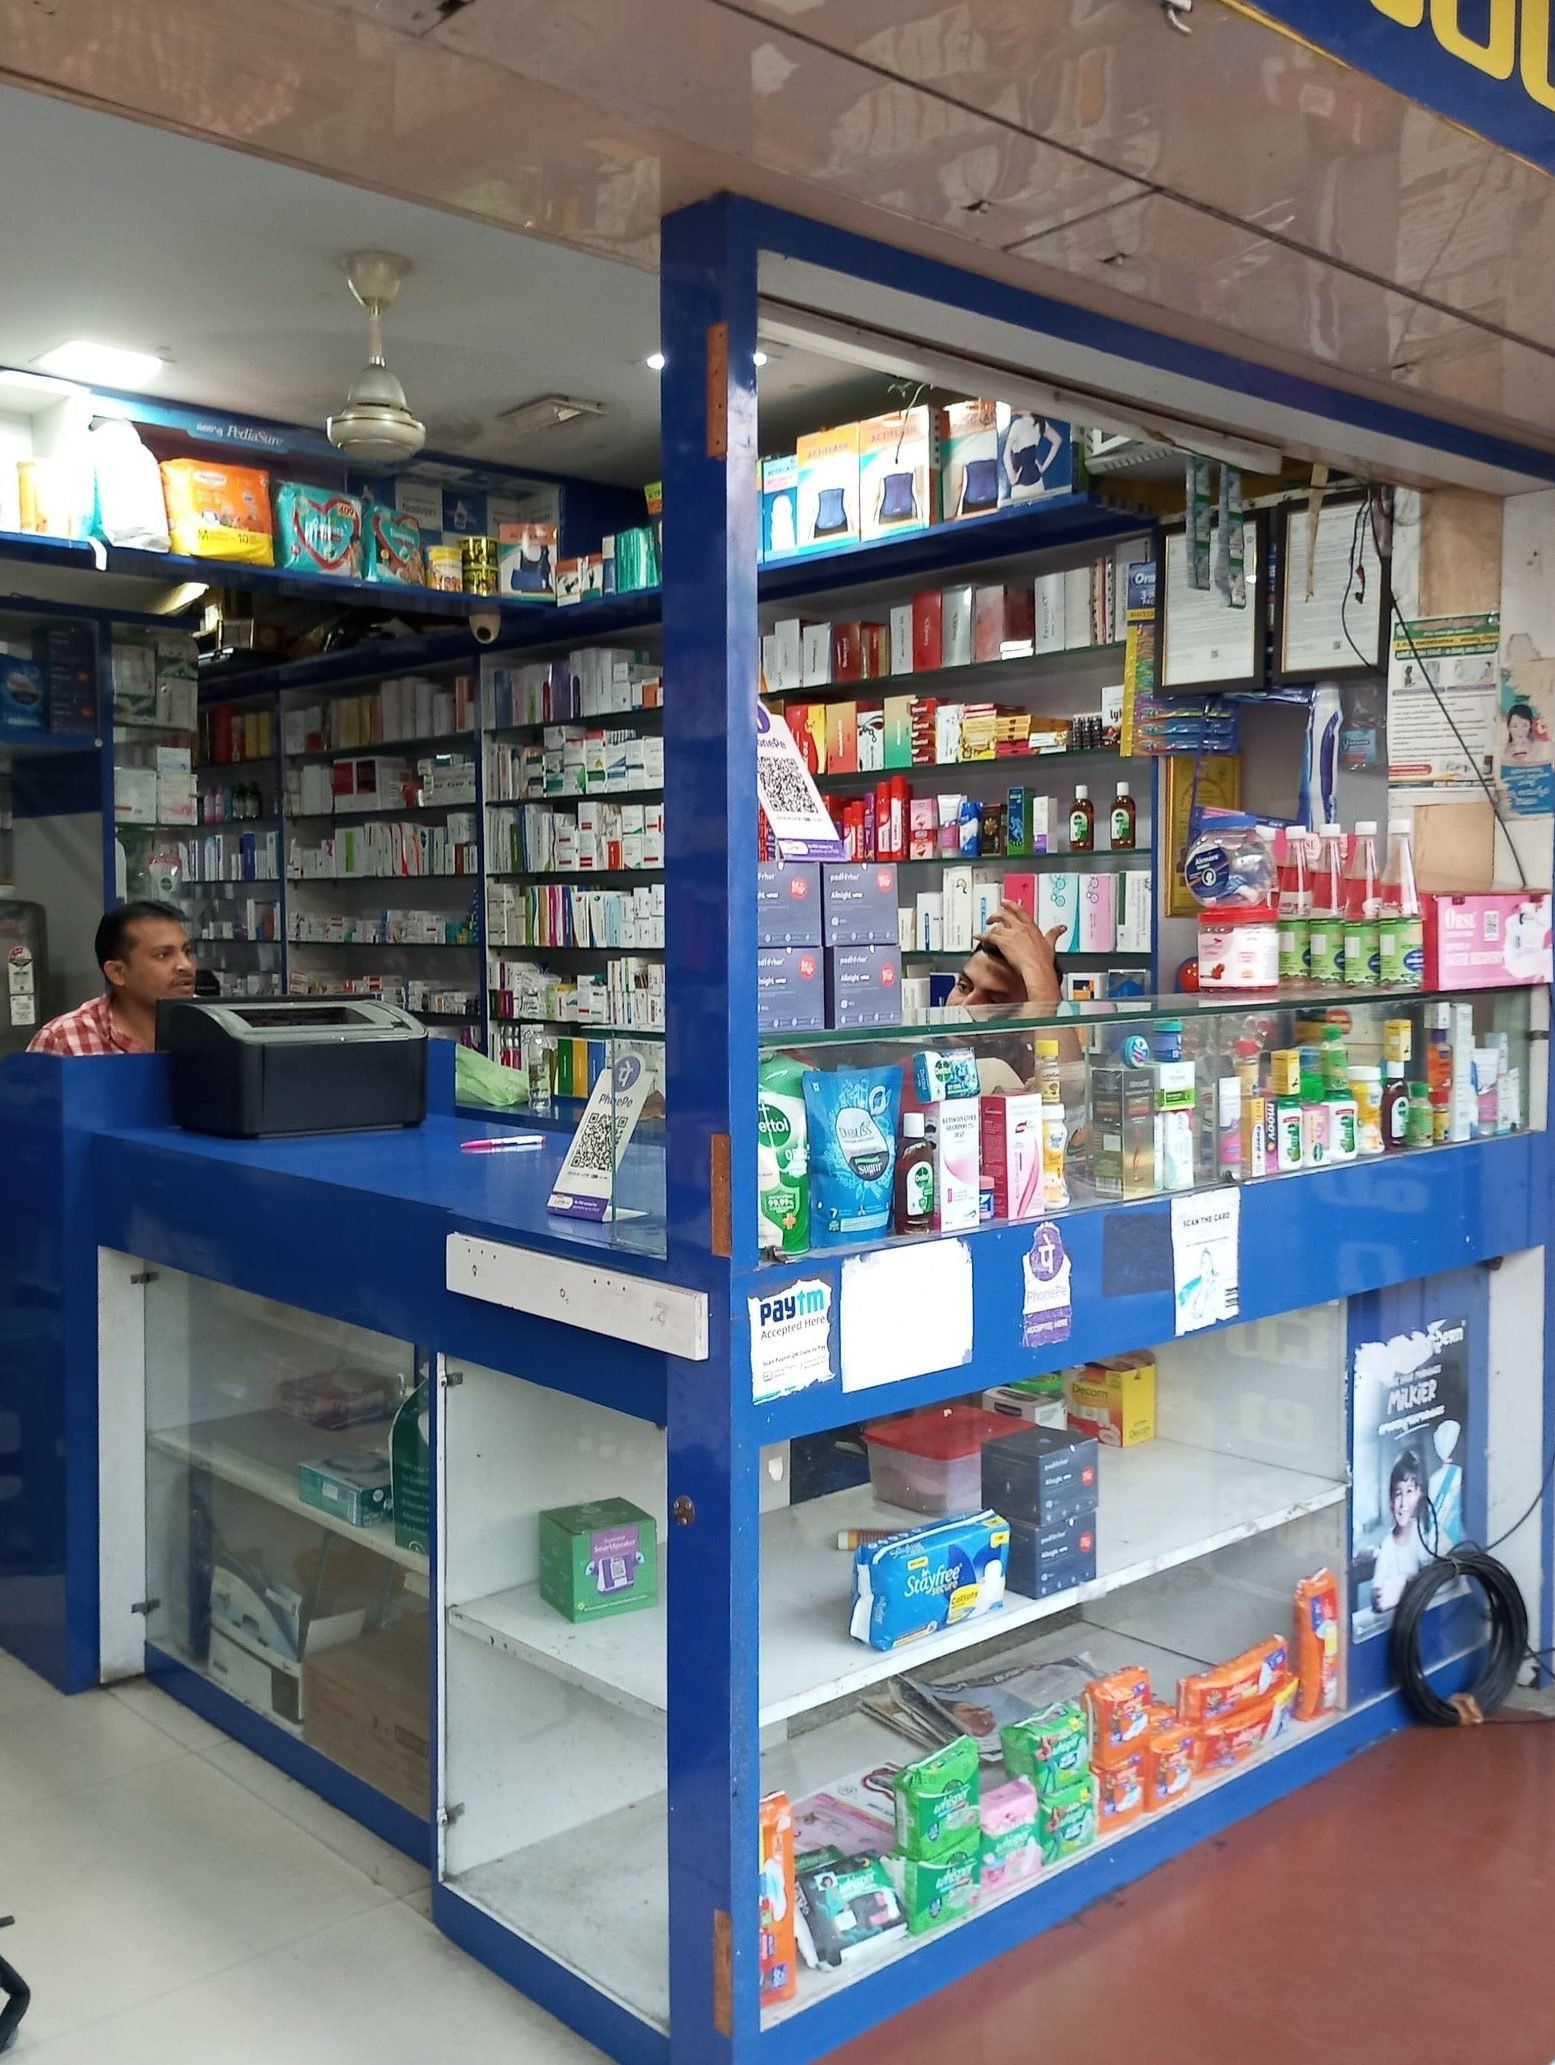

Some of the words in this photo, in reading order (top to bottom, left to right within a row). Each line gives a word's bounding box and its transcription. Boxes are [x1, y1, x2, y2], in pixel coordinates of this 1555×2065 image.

[227, 425, 283, 445] PediaSure
[1135, 573, 1155, 584] Ora
[758, 1117, 790, 1133] ettol
[1183, 1218, 1199, 1229] SCAN
[1201, 1216, 1213, 1224] THE
[1213, 1211, 1231, 1222] CARD
[1027, 1284, 1068, 1304] PhonePe
[761, 1321, 803, 1341] Accepted
[804, 1315, 826, 1329] Here
[904, 1563, 962, 1598] Stayfree
